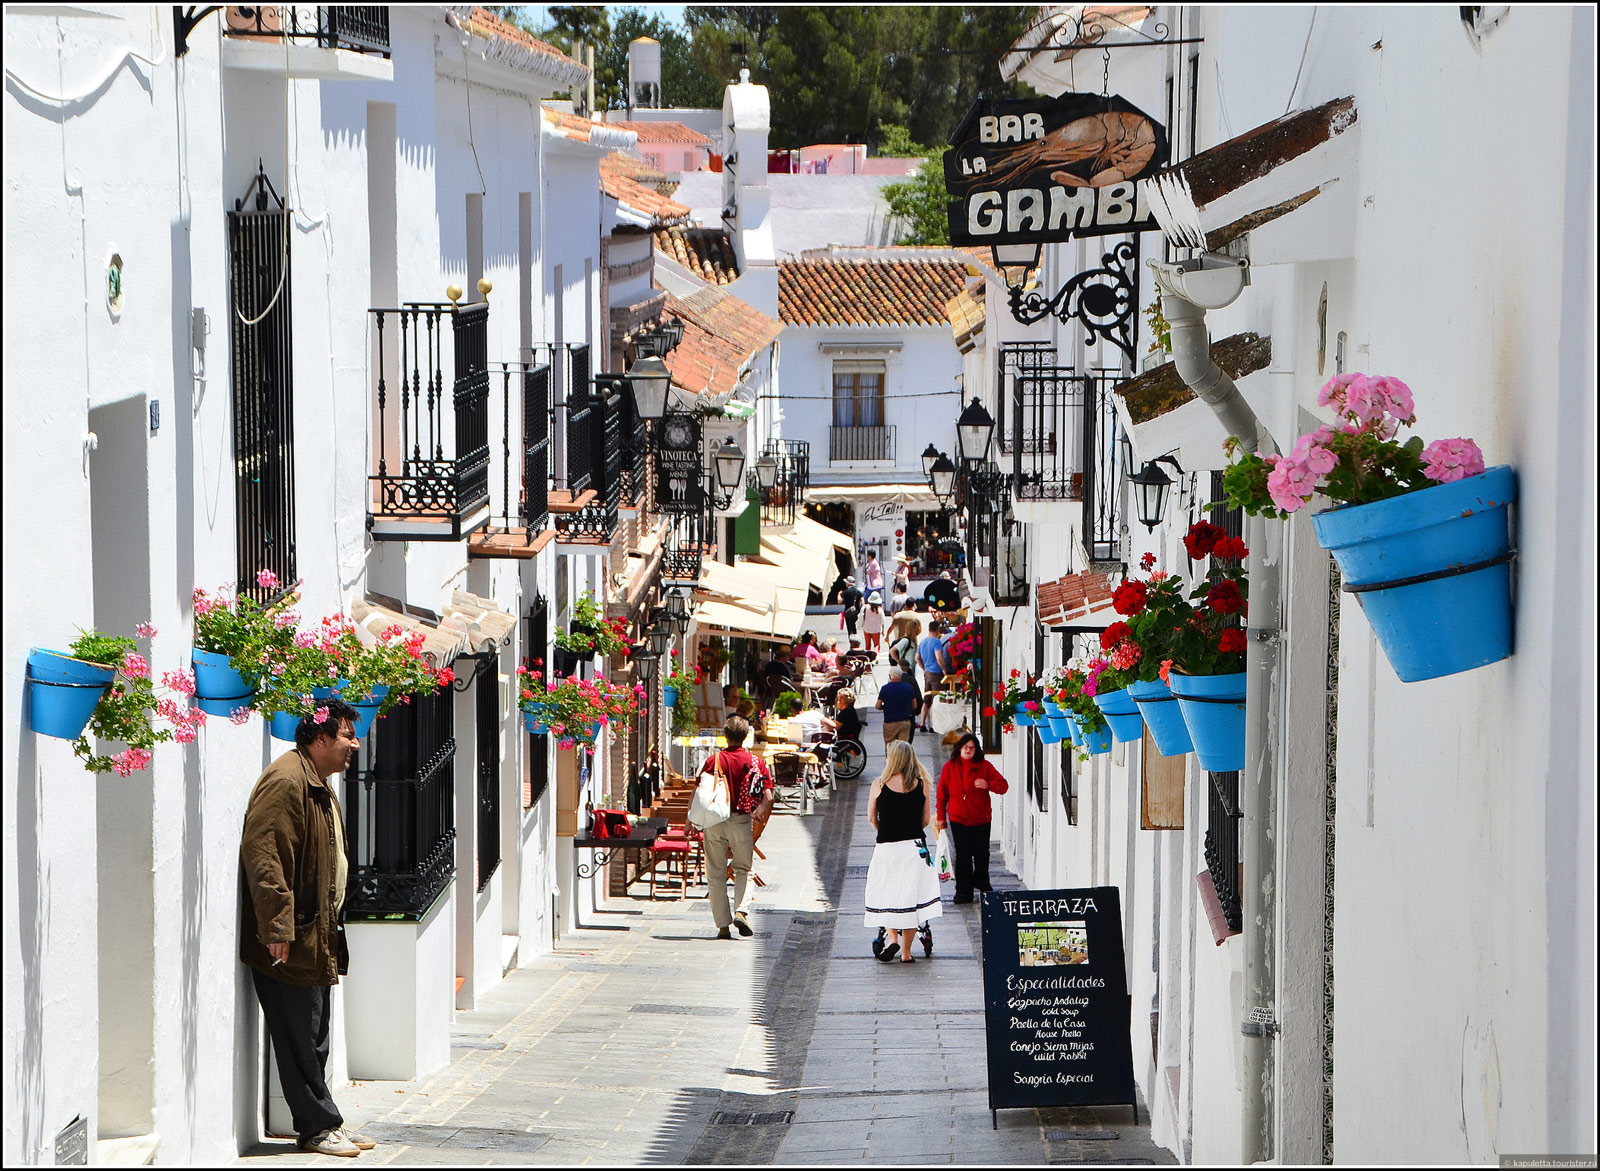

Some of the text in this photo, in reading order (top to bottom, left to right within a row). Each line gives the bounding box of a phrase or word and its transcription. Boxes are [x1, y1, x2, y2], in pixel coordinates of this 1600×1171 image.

[979, 113, 1045, 143] BAR
[962, 156, 987, 175] LA
[660, 450, 697, 461] VINOTECA
[1003, 898, 1098, 917] TERRAZA
[1006, 974, 1106, 994] Especialidades
[1053, 995, 1089, 1008] Andaluz
[1009, 1016, 1086, 1029] Paella de la Casa
[1034, 1029, 1082, 1039] House Paella
[1010, 1040, 1041, 1055] Conejo
[1042, 1041, 1069, 1051] Sierra
[1056, 1072, 1095, 1086] Especial
